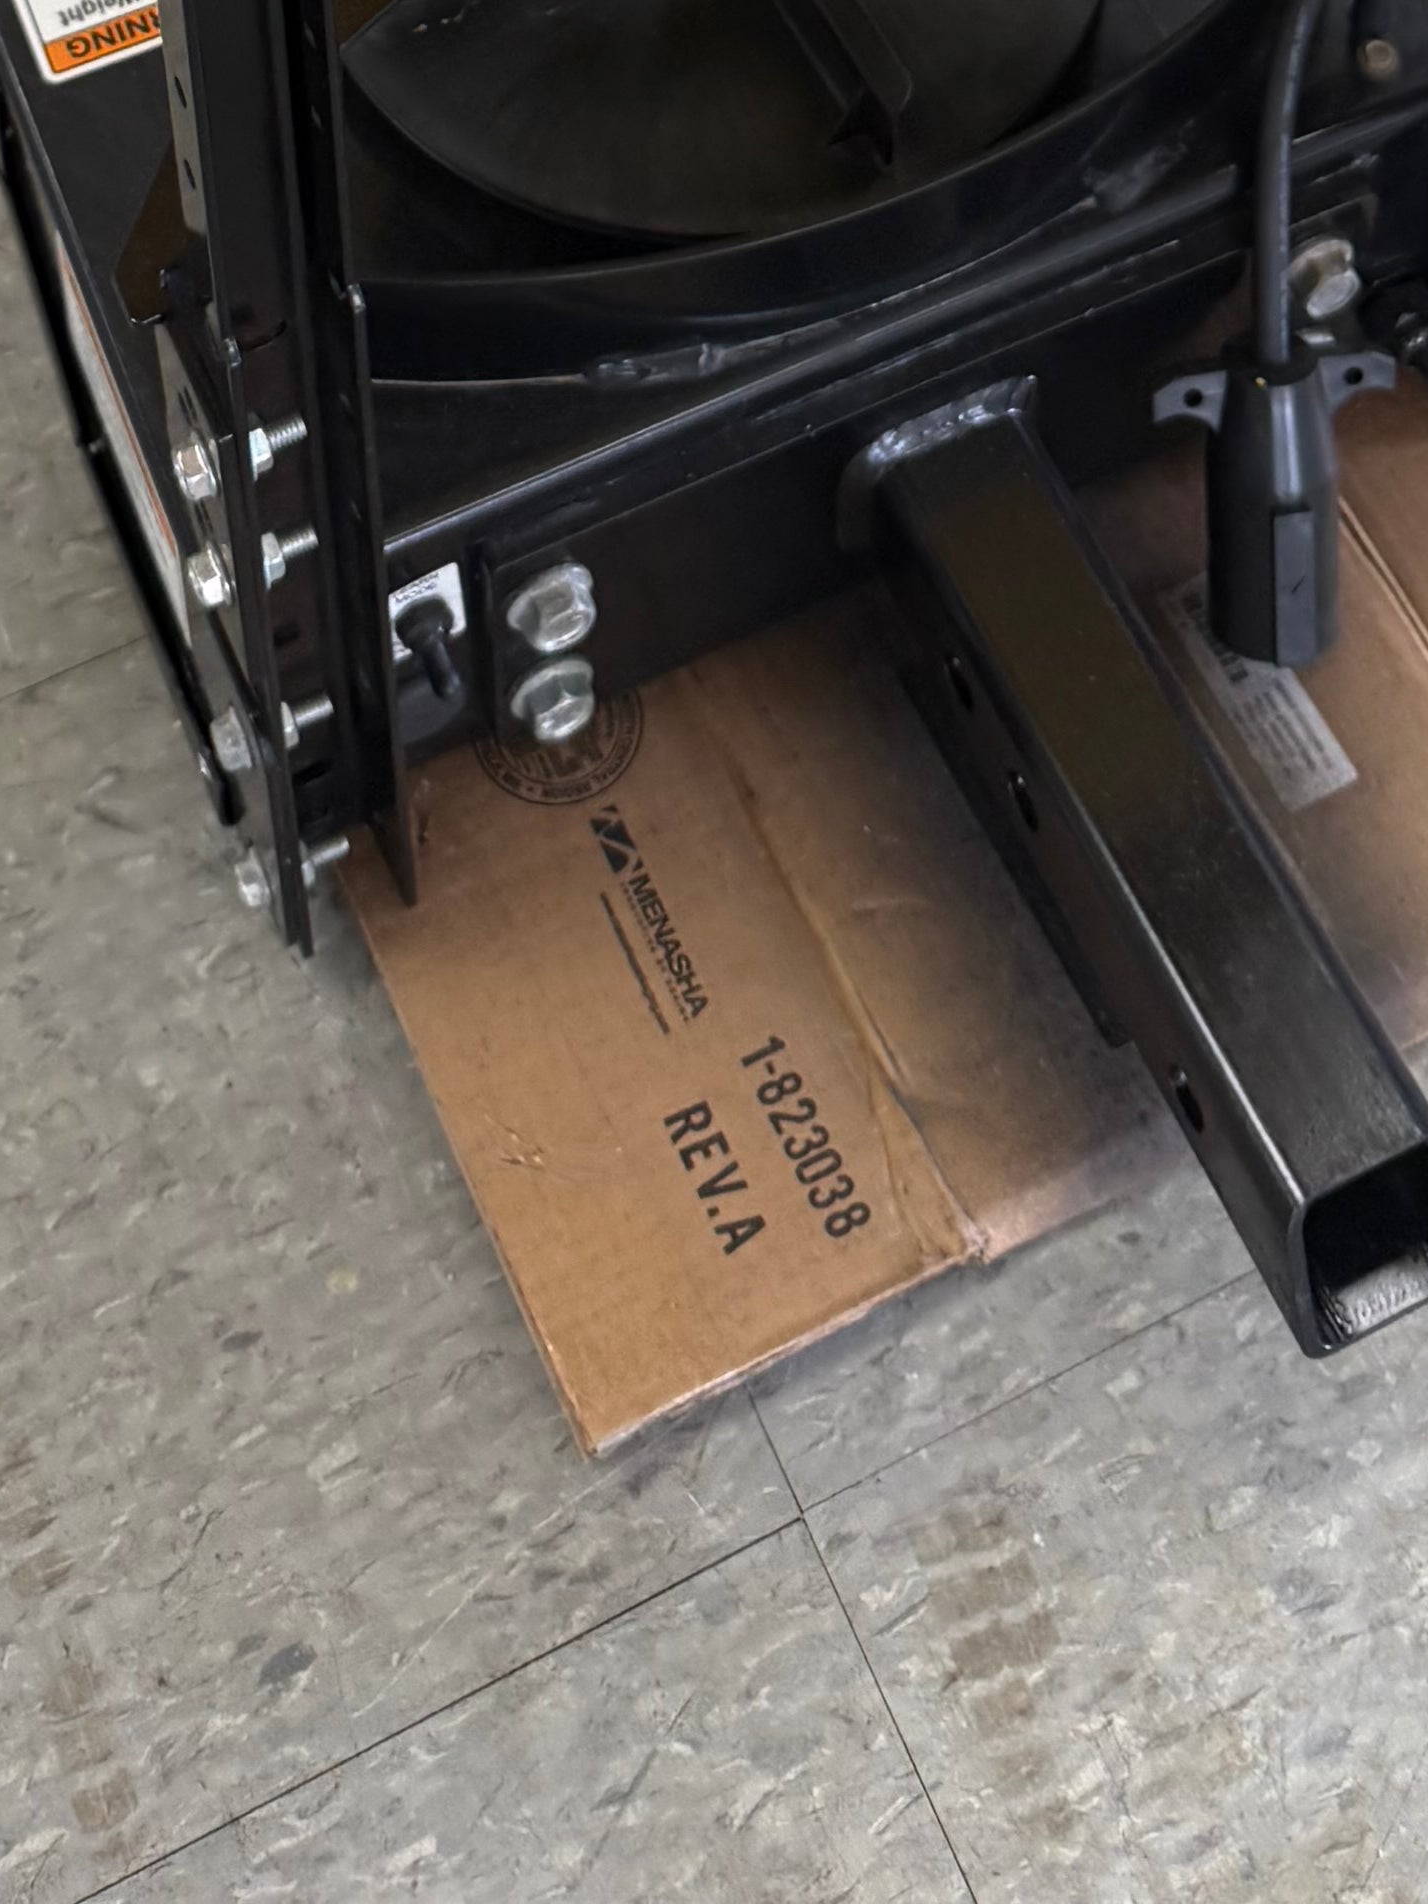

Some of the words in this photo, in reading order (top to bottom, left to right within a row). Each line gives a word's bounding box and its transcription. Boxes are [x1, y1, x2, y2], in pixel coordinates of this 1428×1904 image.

[628, 870, 710, 1021] MENASHA
[663, 1100, 767, 1256] REV.A
[740, 1033, 872, 1239] 1-823038
